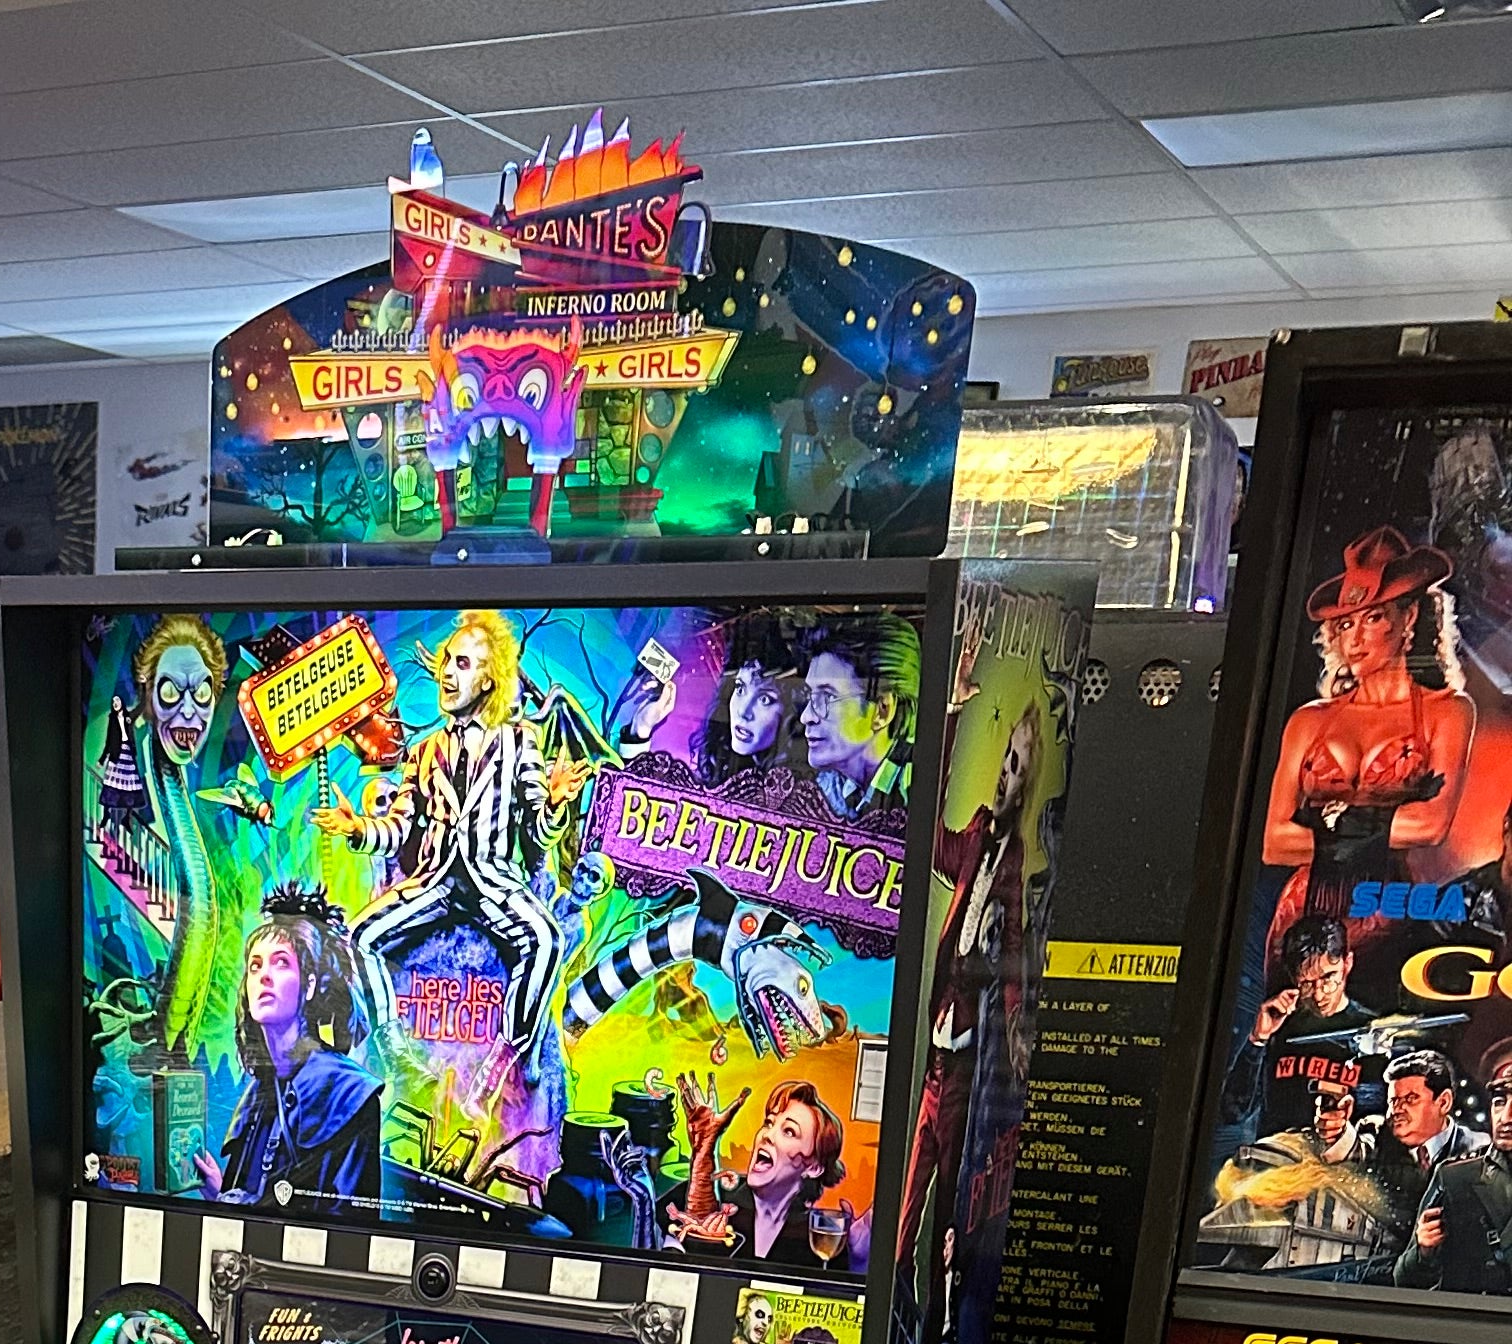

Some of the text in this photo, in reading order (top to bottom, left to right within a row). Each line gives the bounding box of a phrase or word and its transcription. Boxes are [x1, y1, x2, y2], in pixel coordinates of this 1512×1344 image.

[404, 203, 471, 246] GIRLS
[522, 195, 666, 258] DANTE'S
[527, 290, 666, 317] INFERNO ROOM
[312, 357, 404, 402] GIRLS
[618, 347, 703, 379] GIRLS
[1190, 350, 1264, 393] PINBA
[266, 639, 355, 711] BETELGEUSE
[277, 662, 367, 738] BETELGEUSE
[1349, 881, 1468, 922] SEGA
[1108, 952, 1178, 977] ATTENZIO
[411, 970, 502, 1004] here lies
[397, 996, 503, 1044] ETELGEU
[1041, 1031, 1090, 1044] INSTALLED
[1275, 1056, 1362, 1088] WIRED
[1011, 1190, 1072, 1202] NTERCALANT
[259, 1324, 323, 1342] FRIGHTS
[268, 1308, 298, 1324] FUN
